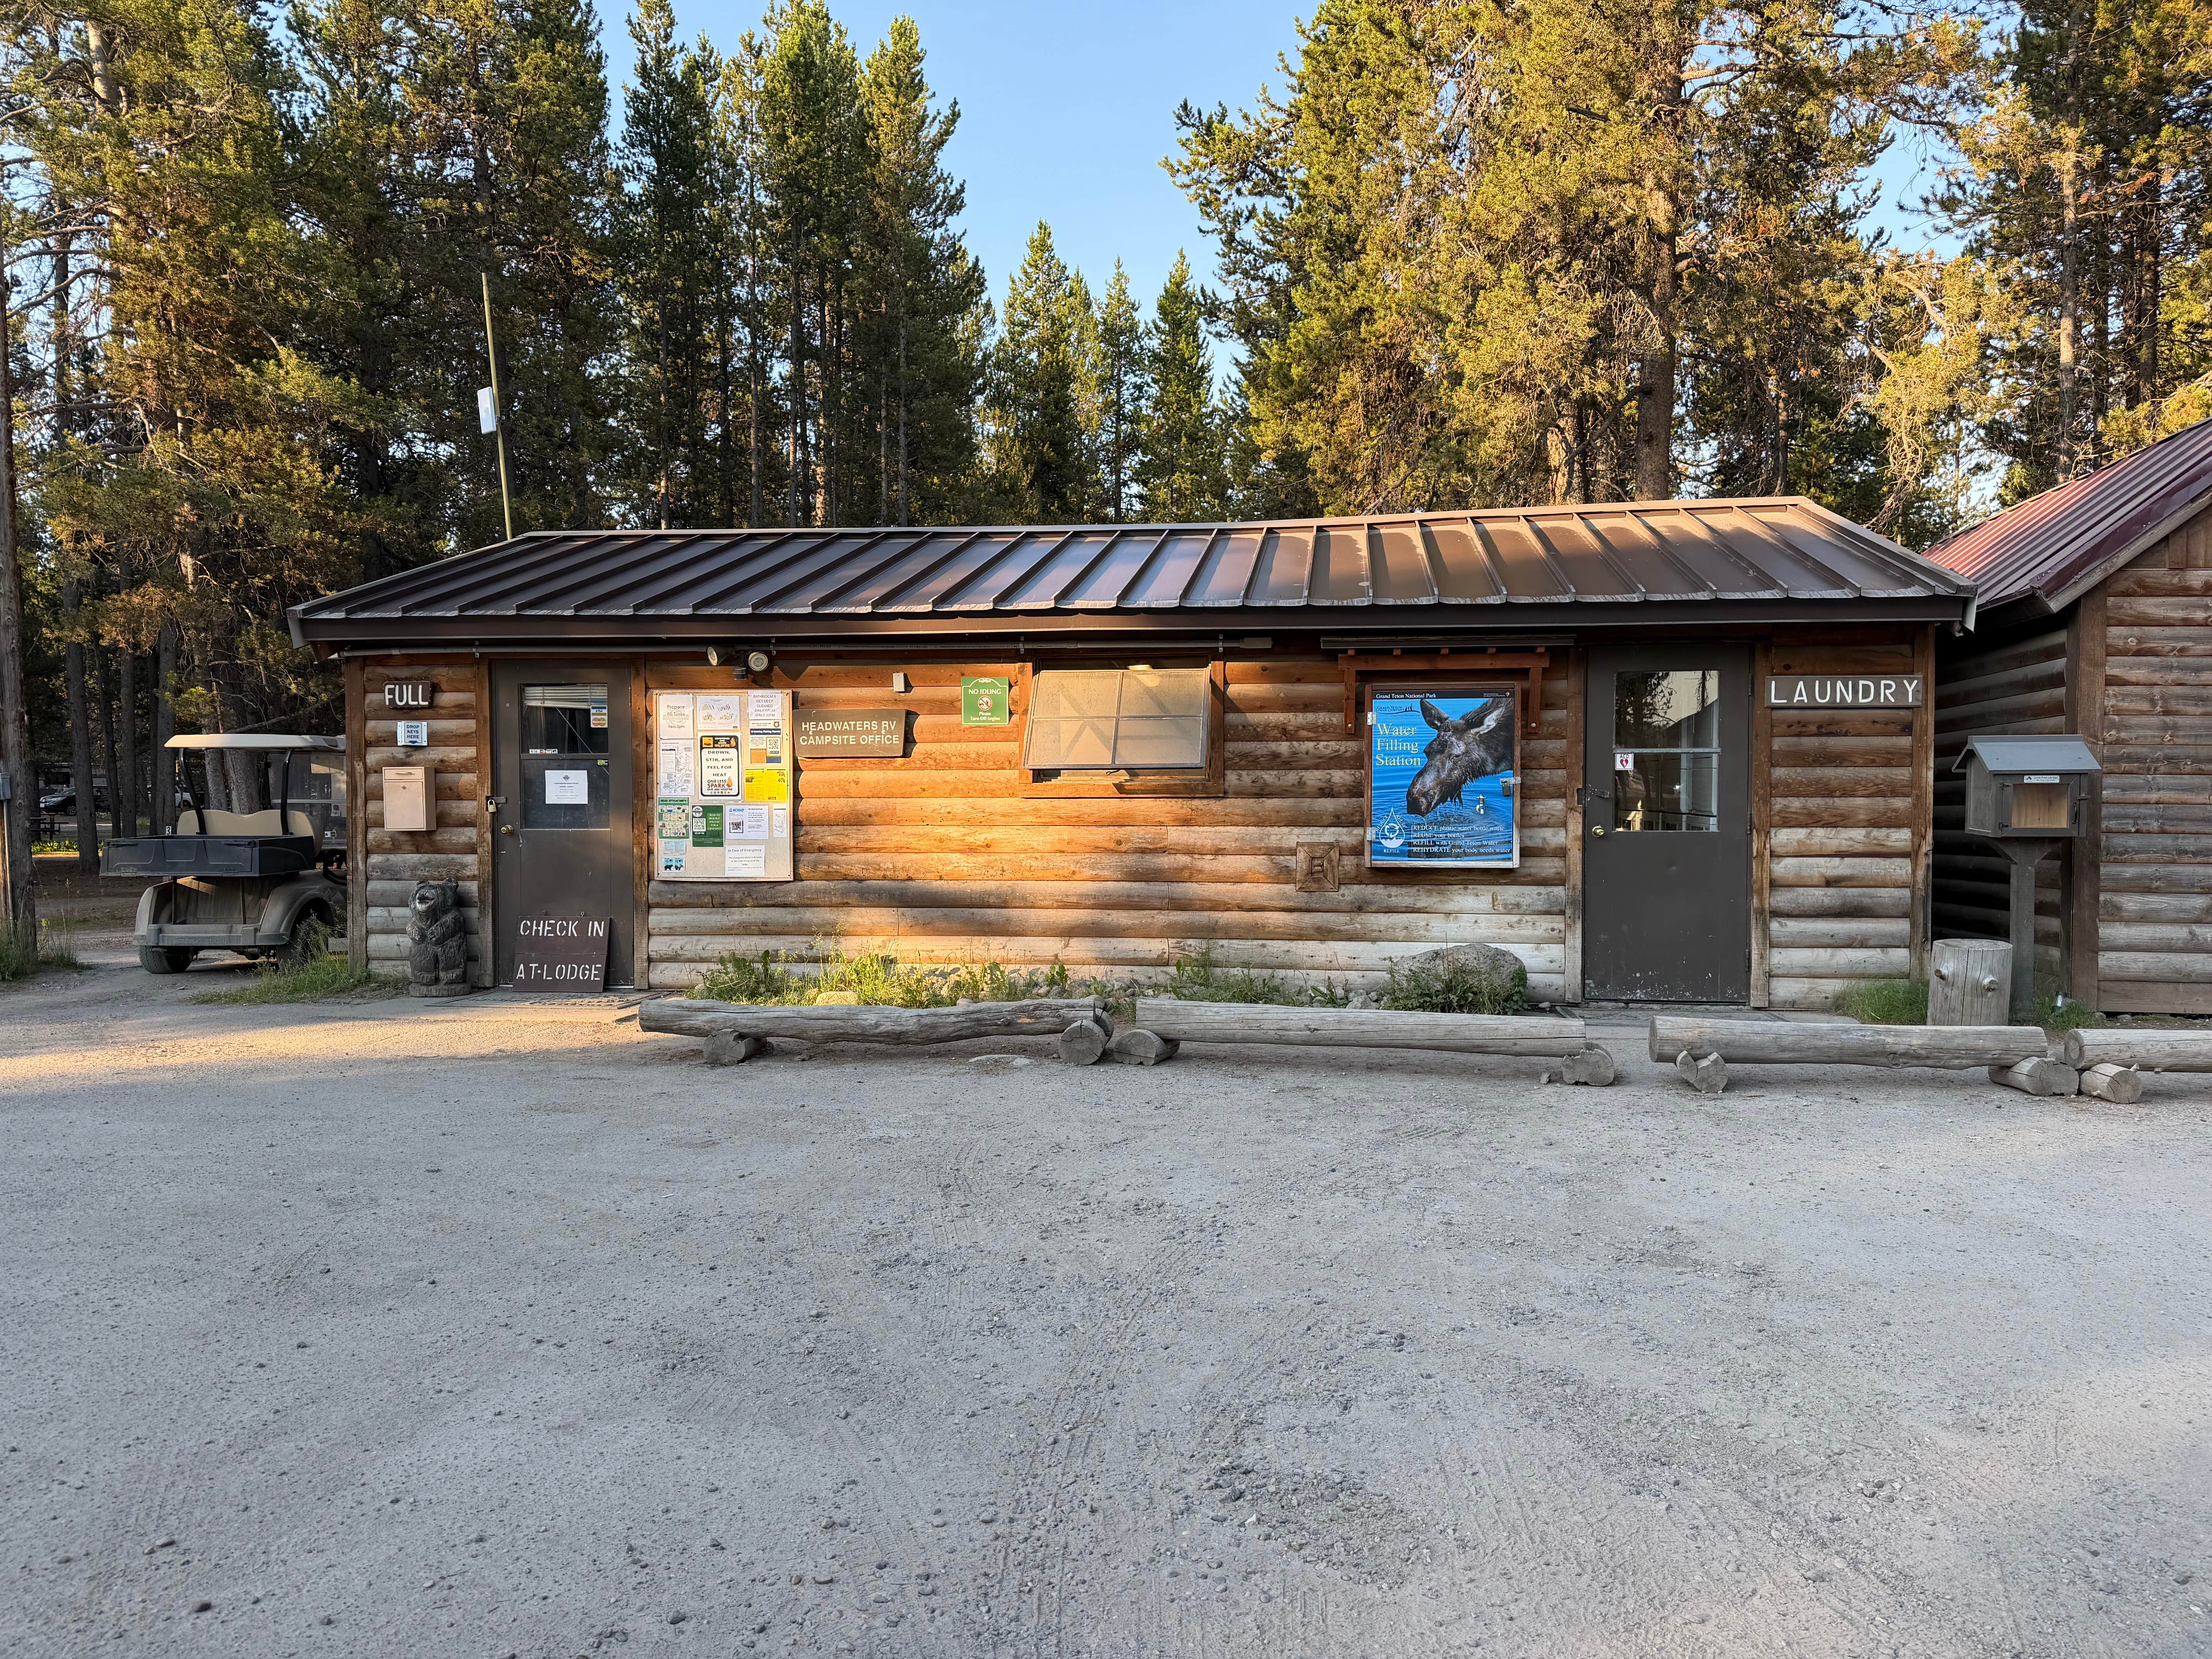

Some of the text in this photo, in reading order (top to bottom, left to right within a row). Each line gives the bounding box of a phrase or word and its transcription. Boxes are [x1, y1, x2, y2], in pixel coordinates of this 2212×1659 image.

[385, 685, 428, 705] FULL
[1771, 680, 1917, 703] LAUNDRY
[802, 721, 896, 731] HEADWATERS RV
[1378, 723, 1417, 736] Water
[800, 735, 899, 745] CAMPSITE OFFICE
[1377, 738, 1419, 754] Filling
[1376, 754, 1421, 766] Station
[1396, 814, 1407, 829] REUSE
[167, 826, 170, 835] 3
[520, 920, 604, 937] CHECK IN
